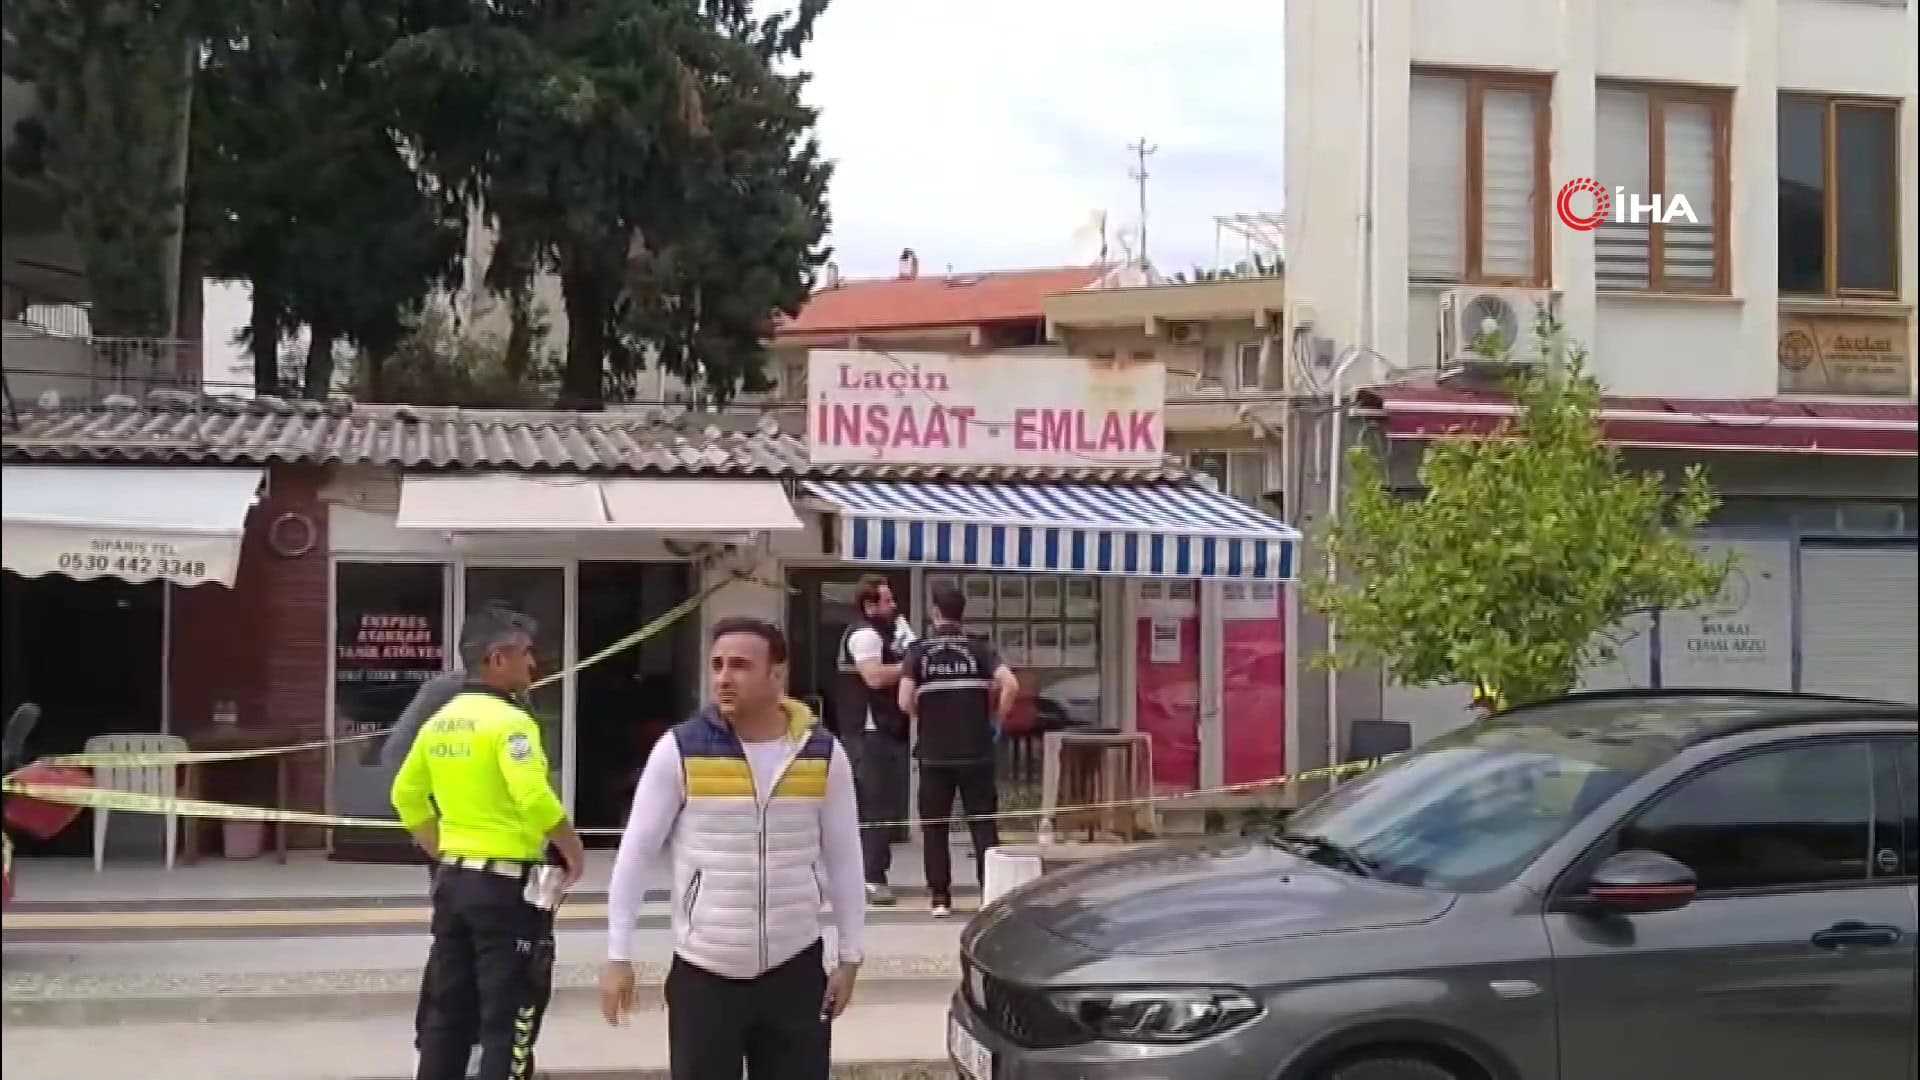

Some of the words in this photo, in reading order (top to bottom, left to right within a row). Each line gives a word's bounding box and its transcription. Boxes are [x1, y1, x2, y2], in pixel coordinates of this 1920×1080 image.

[839, 364, 949, 397] Laçin
[818, 391, 977, 460] İNŞAAT
[1014, 409, 1157, 452] EMLAK
[58, 553, 109, 571] 0530
[114, 556, 151, 574] 442
[156, 559, 207, 577] 3348
